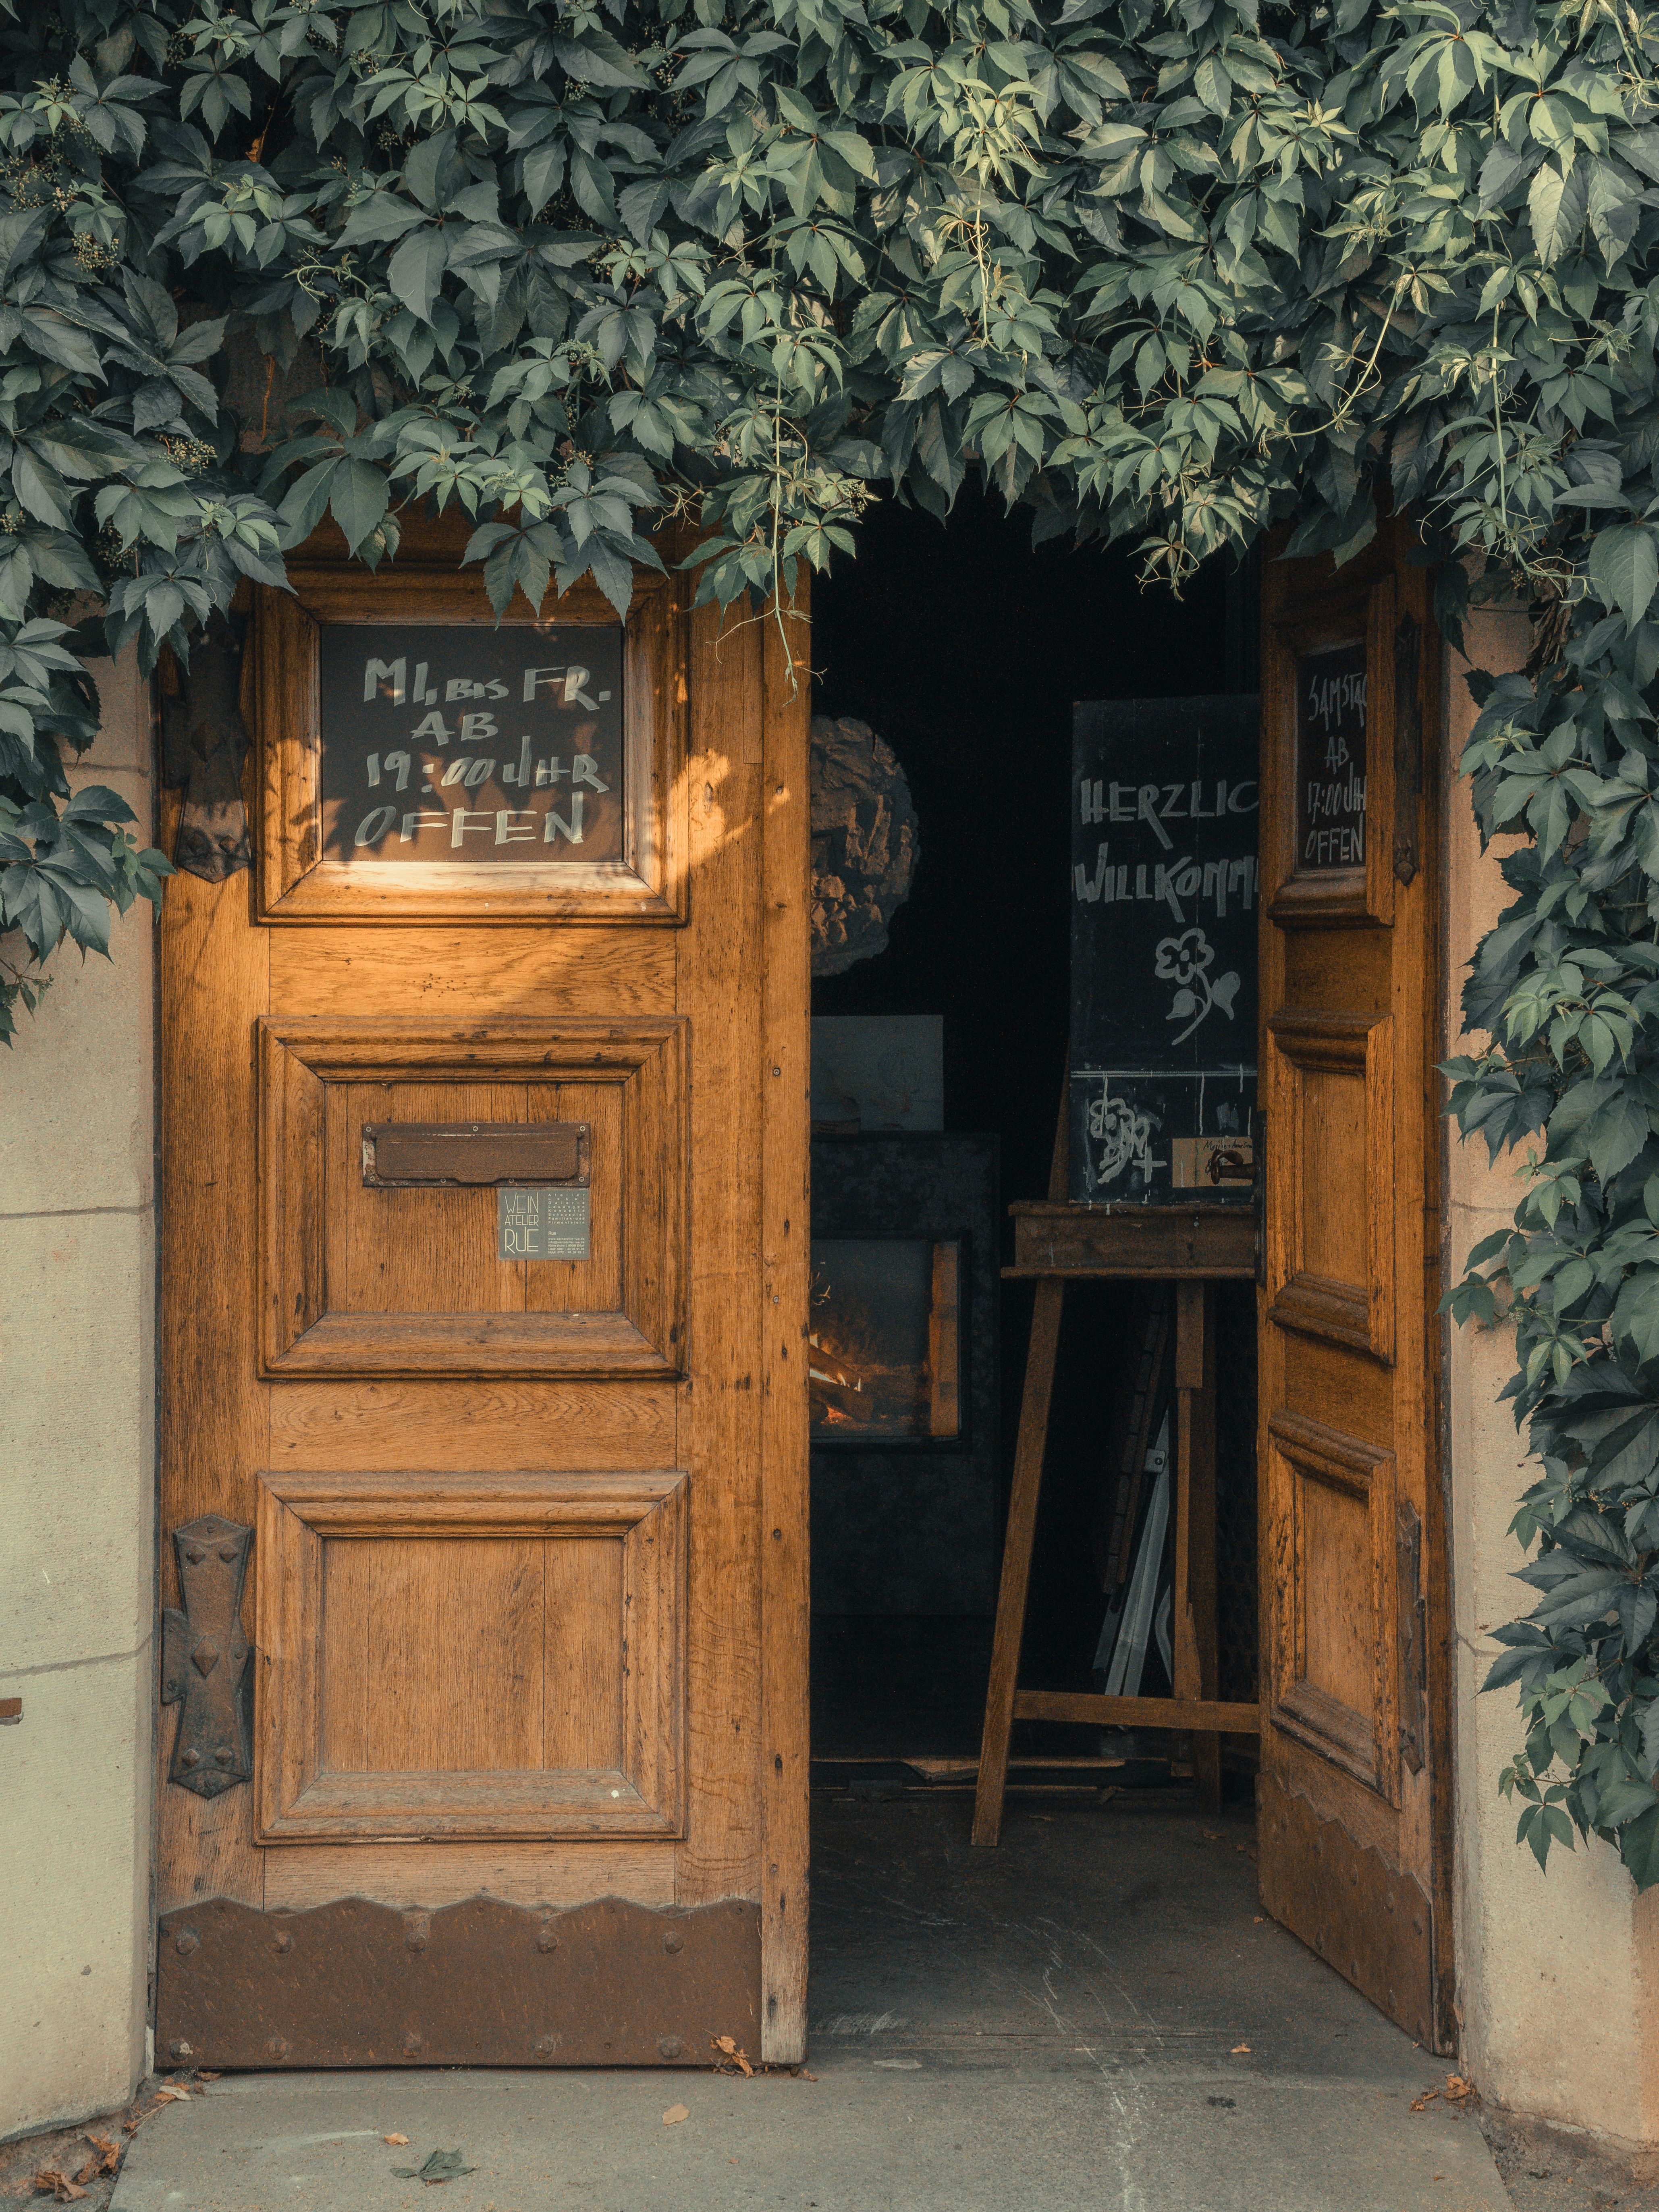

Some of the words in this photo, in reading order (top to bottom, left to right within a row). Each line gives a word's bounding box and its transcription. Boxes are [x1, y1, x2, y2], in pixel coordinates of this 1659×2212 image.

[523, 665, 611, 711] FR.
[409, 711, 499, 746] AB
[367, 750, 497, 793] 19:00
[503, 735, 610, 793] UHR
[1324, 736, 1349, 775] AB
[1343, 762, 1367, 812] UH
[355, 791, 584, 848] OFFEN
[1305, 812, 1363, 864] OFFEN
[1074, 842, 1258, 923] WILLKOMM
[505, 1192, 538, 1213] WEIN
[505, 1215, 539, 1226] ATELIER
[505, 1226, 539, 1254] RUE
